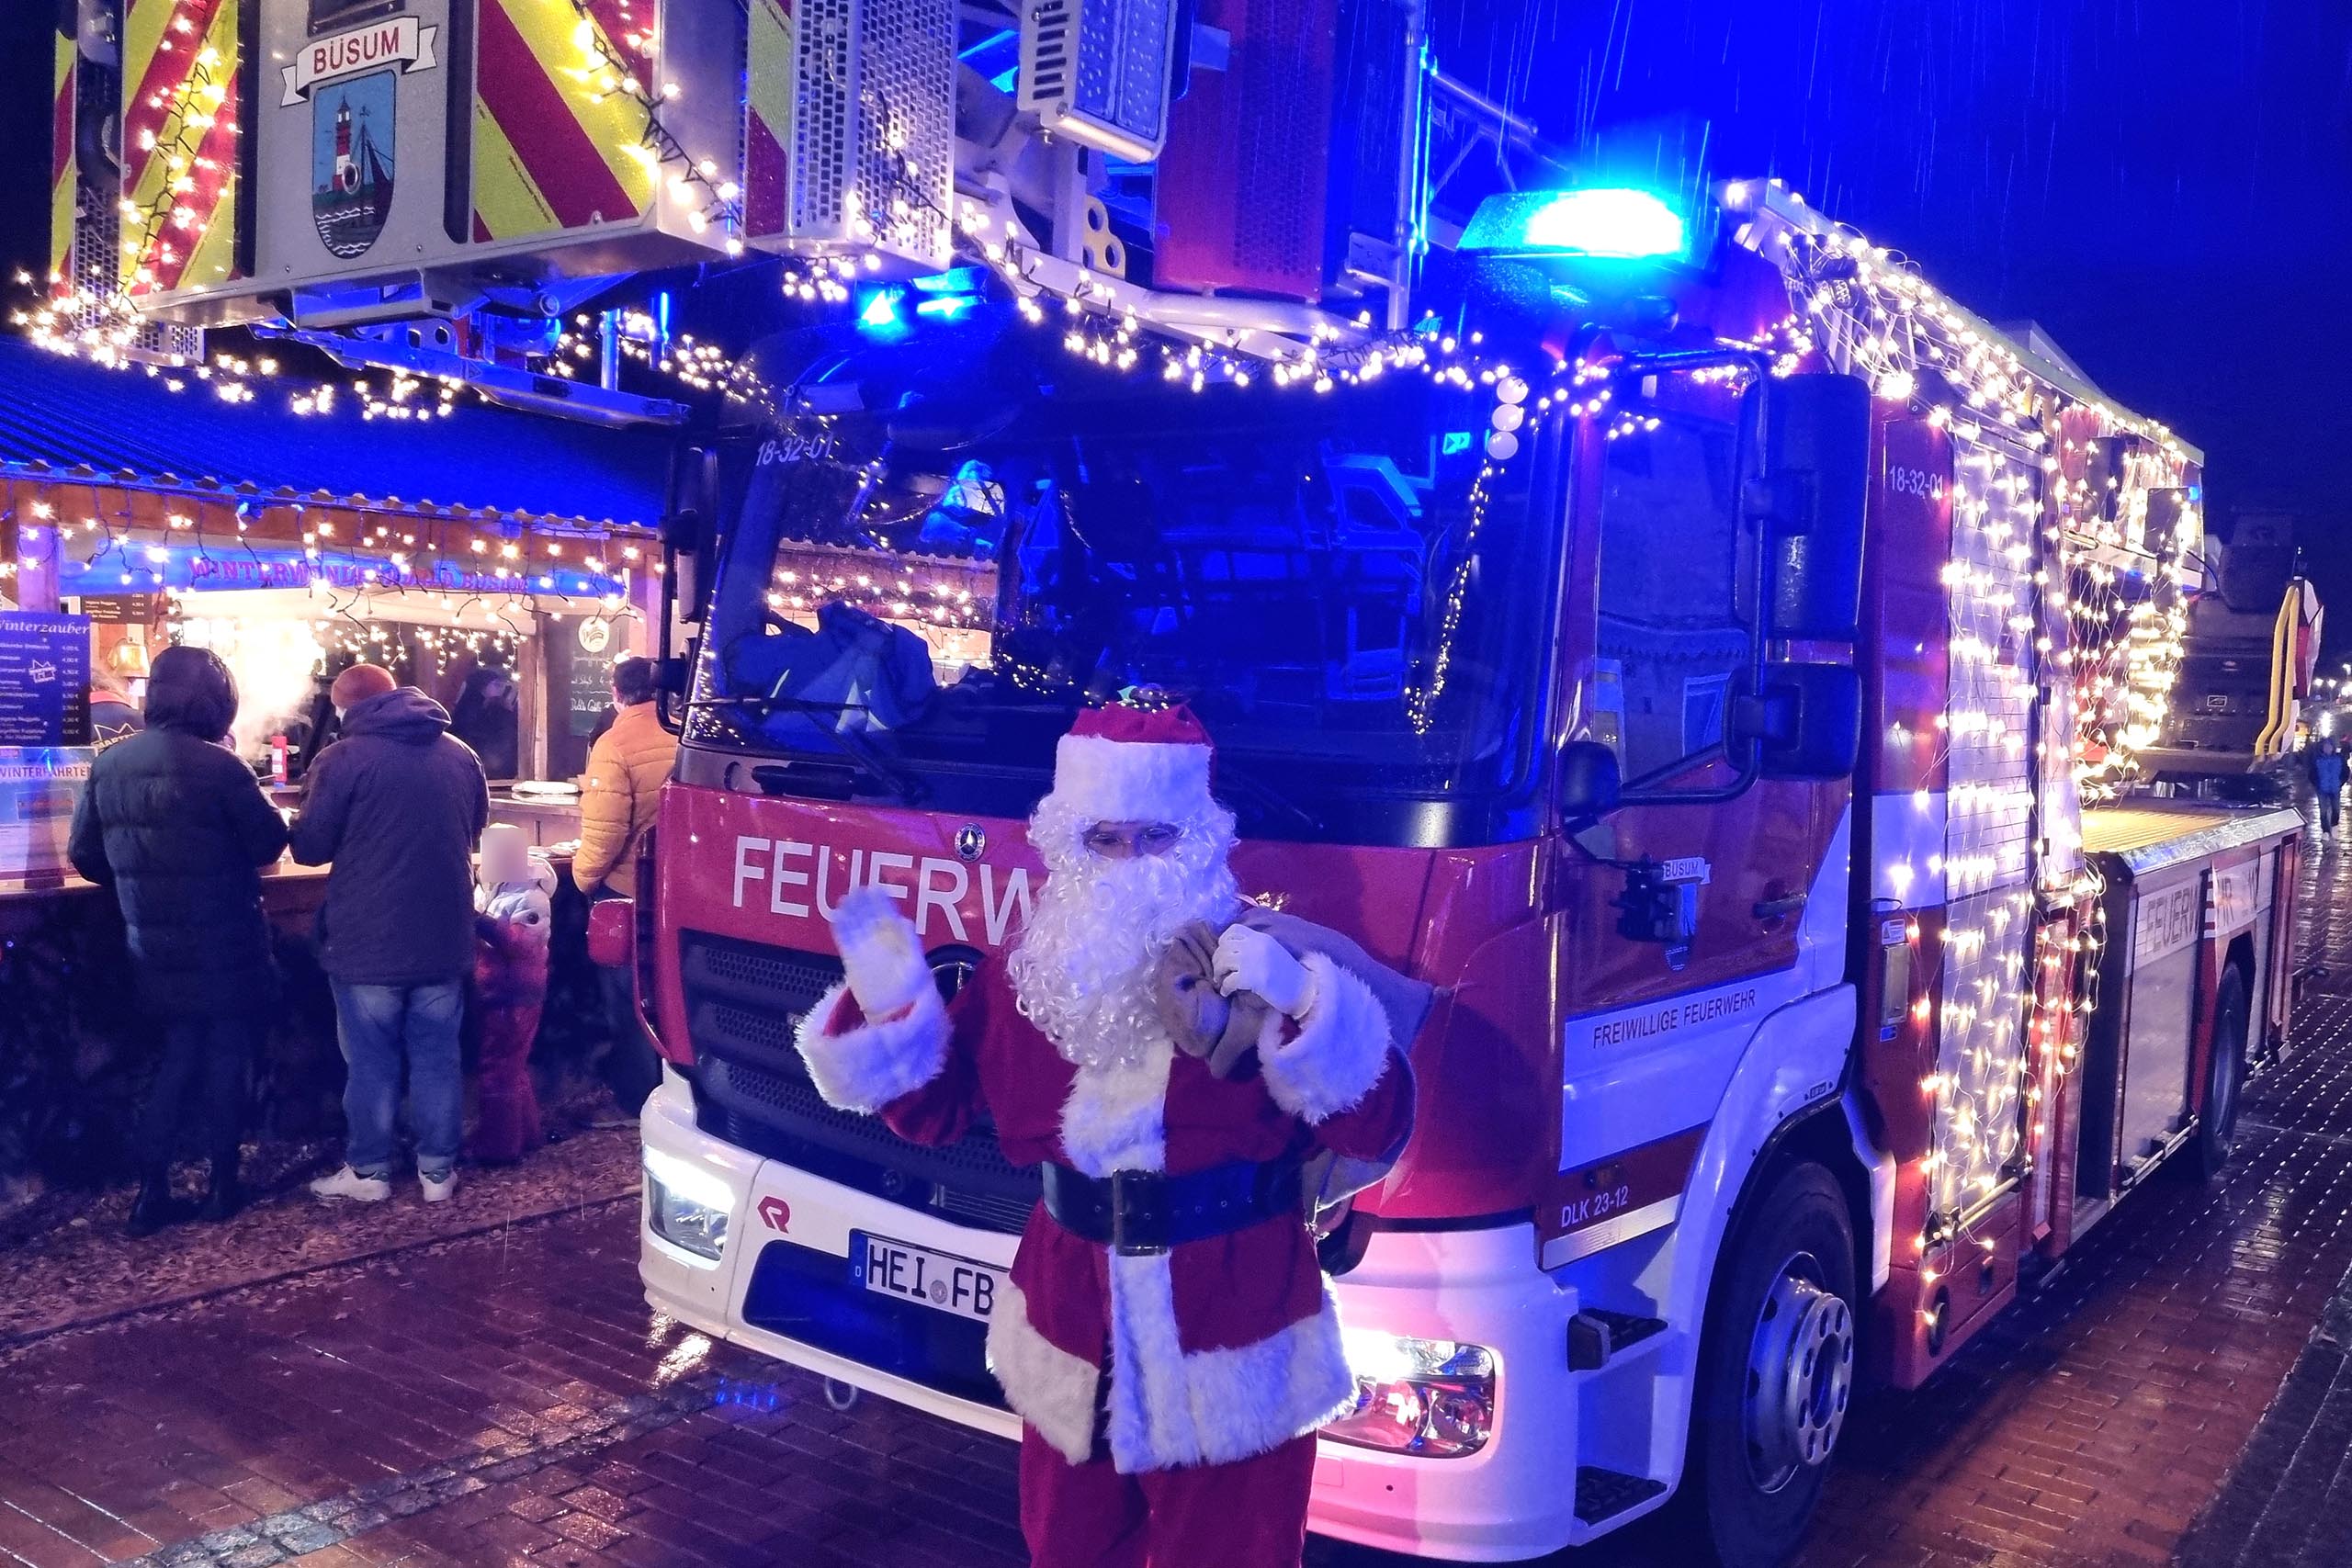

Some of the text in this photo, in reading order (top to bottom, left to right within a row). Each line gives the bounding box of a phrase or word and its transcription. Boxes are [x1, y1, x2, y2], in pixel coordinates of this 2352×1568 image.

[313, 27, 399, 73] BÜSUM
[755, 433, 834, 466] 18-32-01
[1889, 465, 1944, 500] 18-32-01
[1593, 988, 1756, 1049] FREIWILLIGE FEUERWEHR
[1561, 1184, 1629, 1227] DLK 23-12
[868, 1245, 995, 1315] HEI FB
